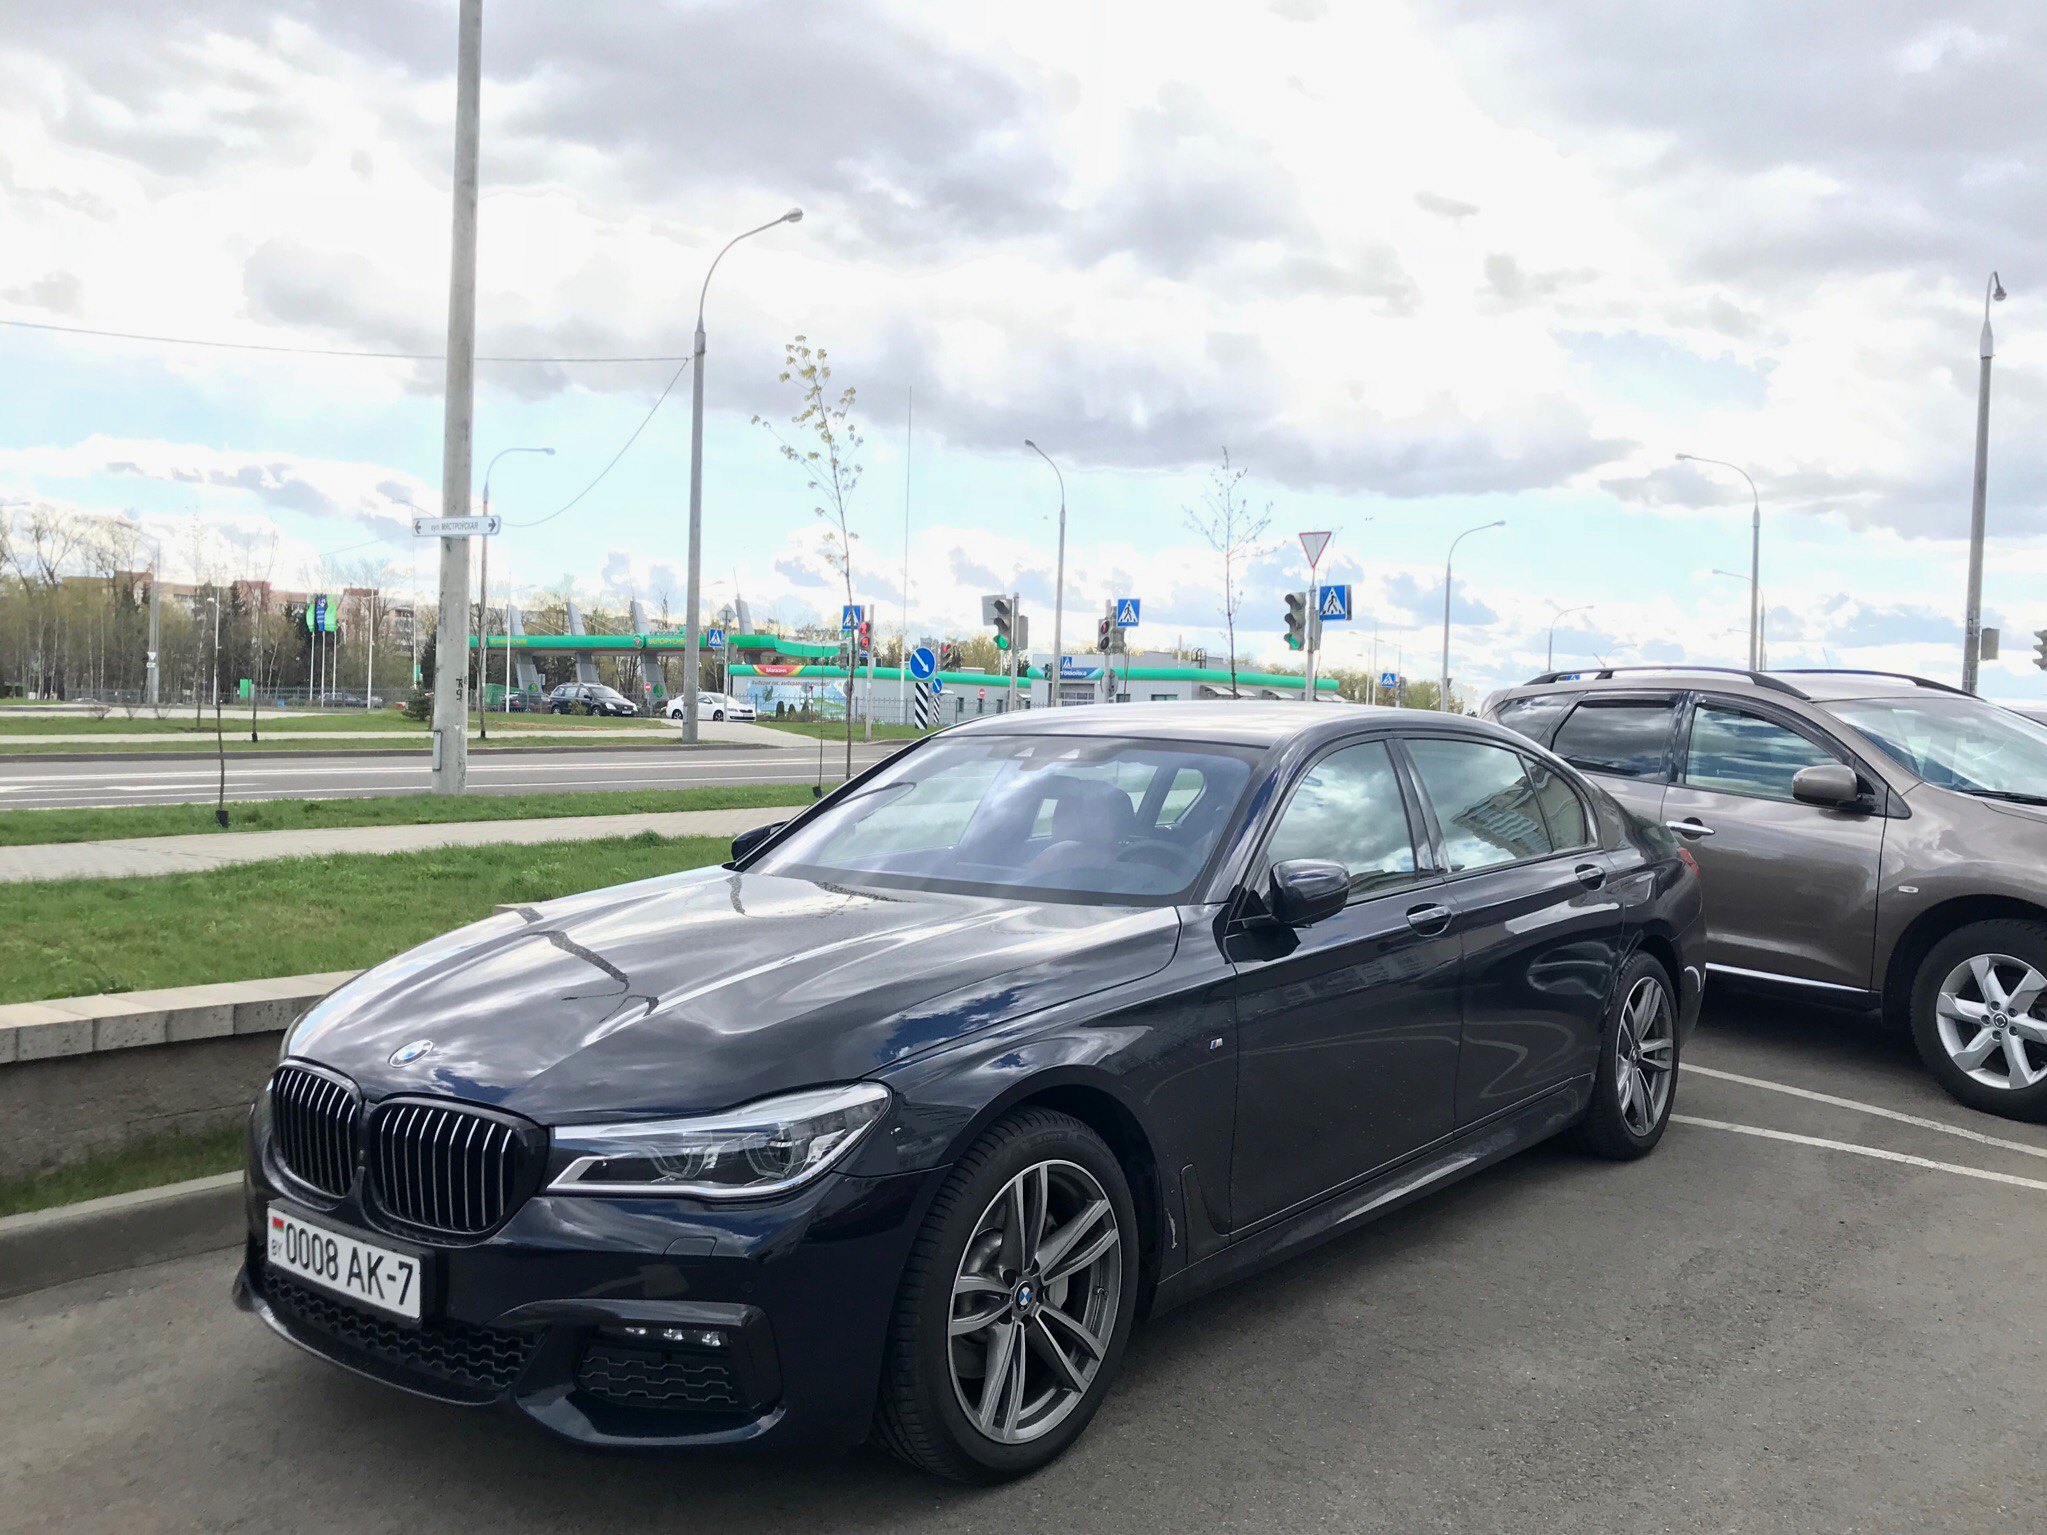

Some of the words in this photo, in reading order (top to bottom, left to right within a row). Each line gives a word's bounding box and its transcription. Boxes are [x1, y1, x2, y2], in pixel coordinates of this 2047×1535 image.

[271, 1238, 284, 1257] BY
[285, 1222, 339, 1281] 0008
[346, 1246, 414, 1306] AK-7
